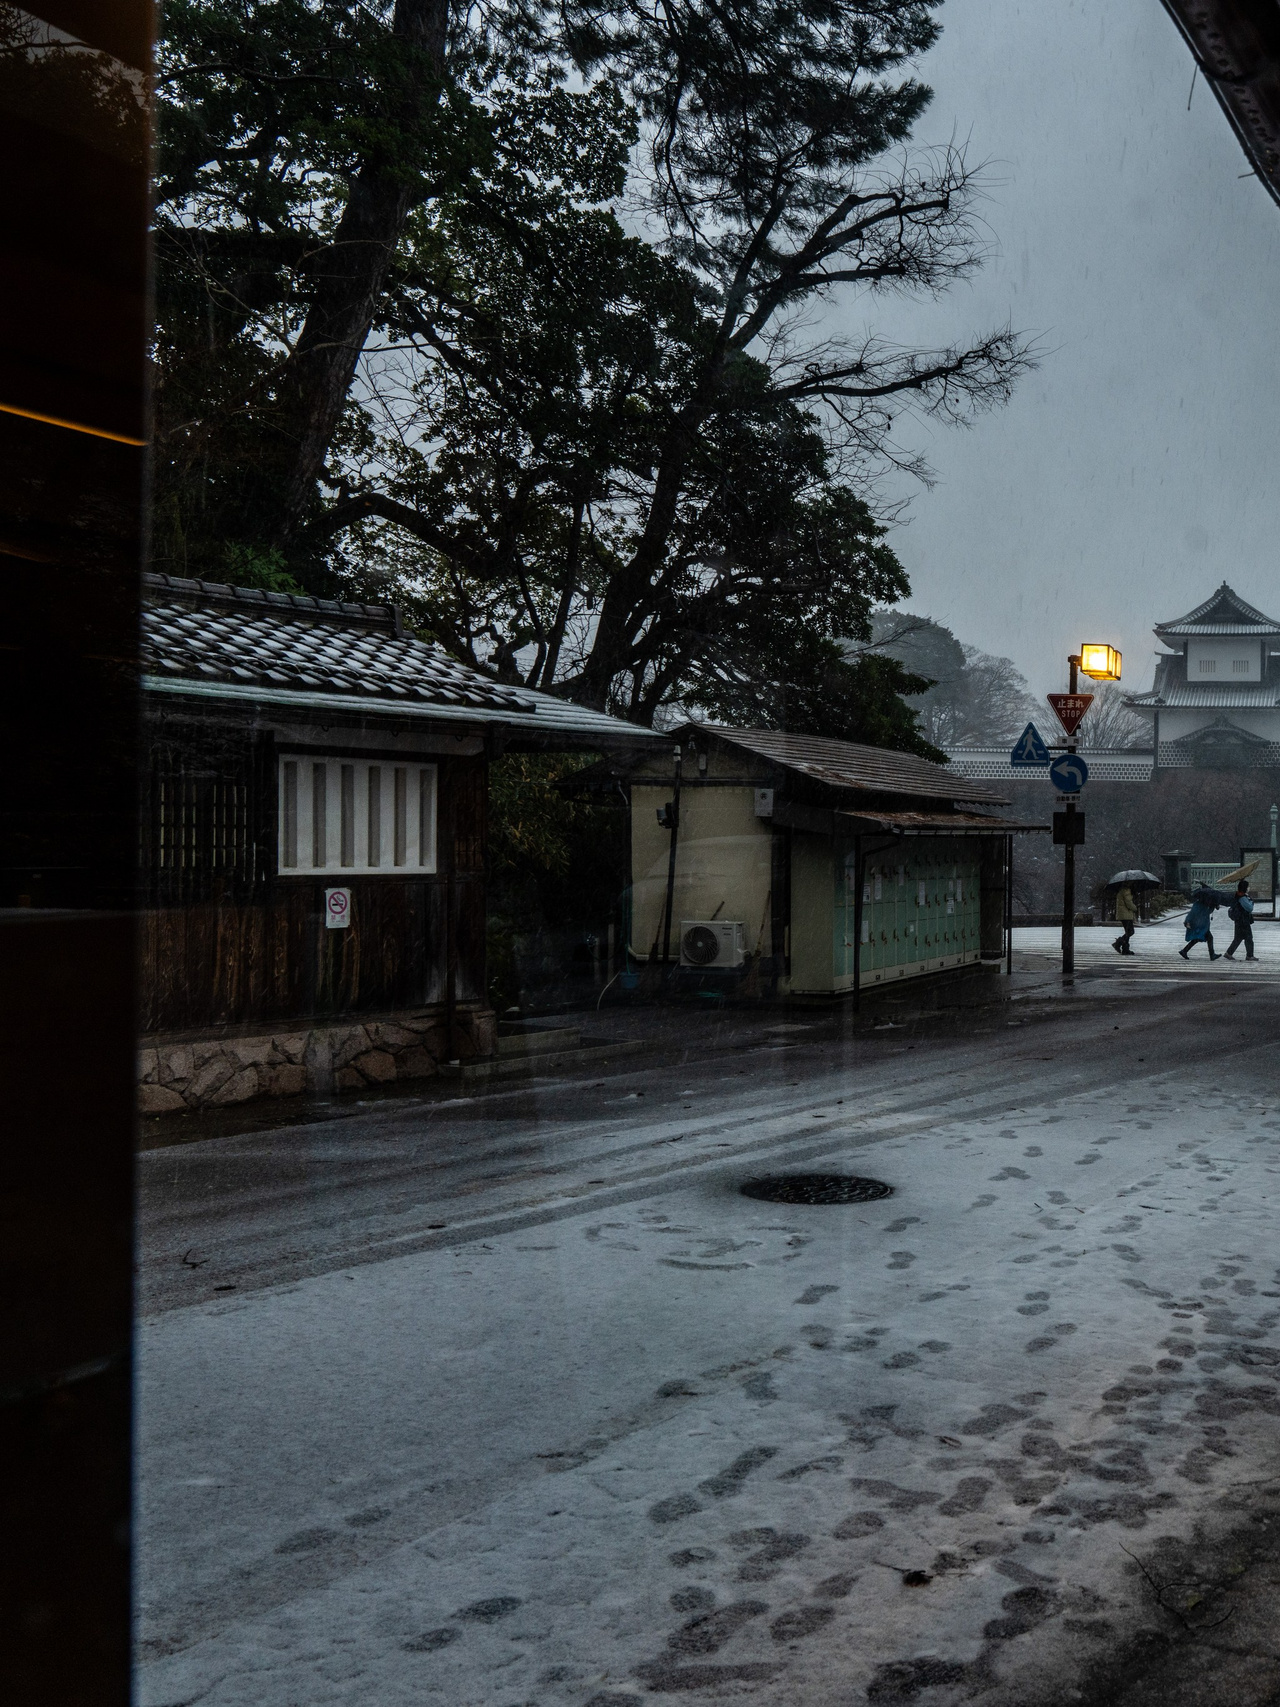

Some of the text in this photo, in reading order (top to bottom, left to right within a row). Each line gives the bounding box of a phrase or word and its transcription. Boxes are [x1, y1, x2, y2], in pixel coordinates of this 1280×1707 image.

[1057, 699, 1084, 708] 止まれ
[1061, 710, 1081, 718] STOP
